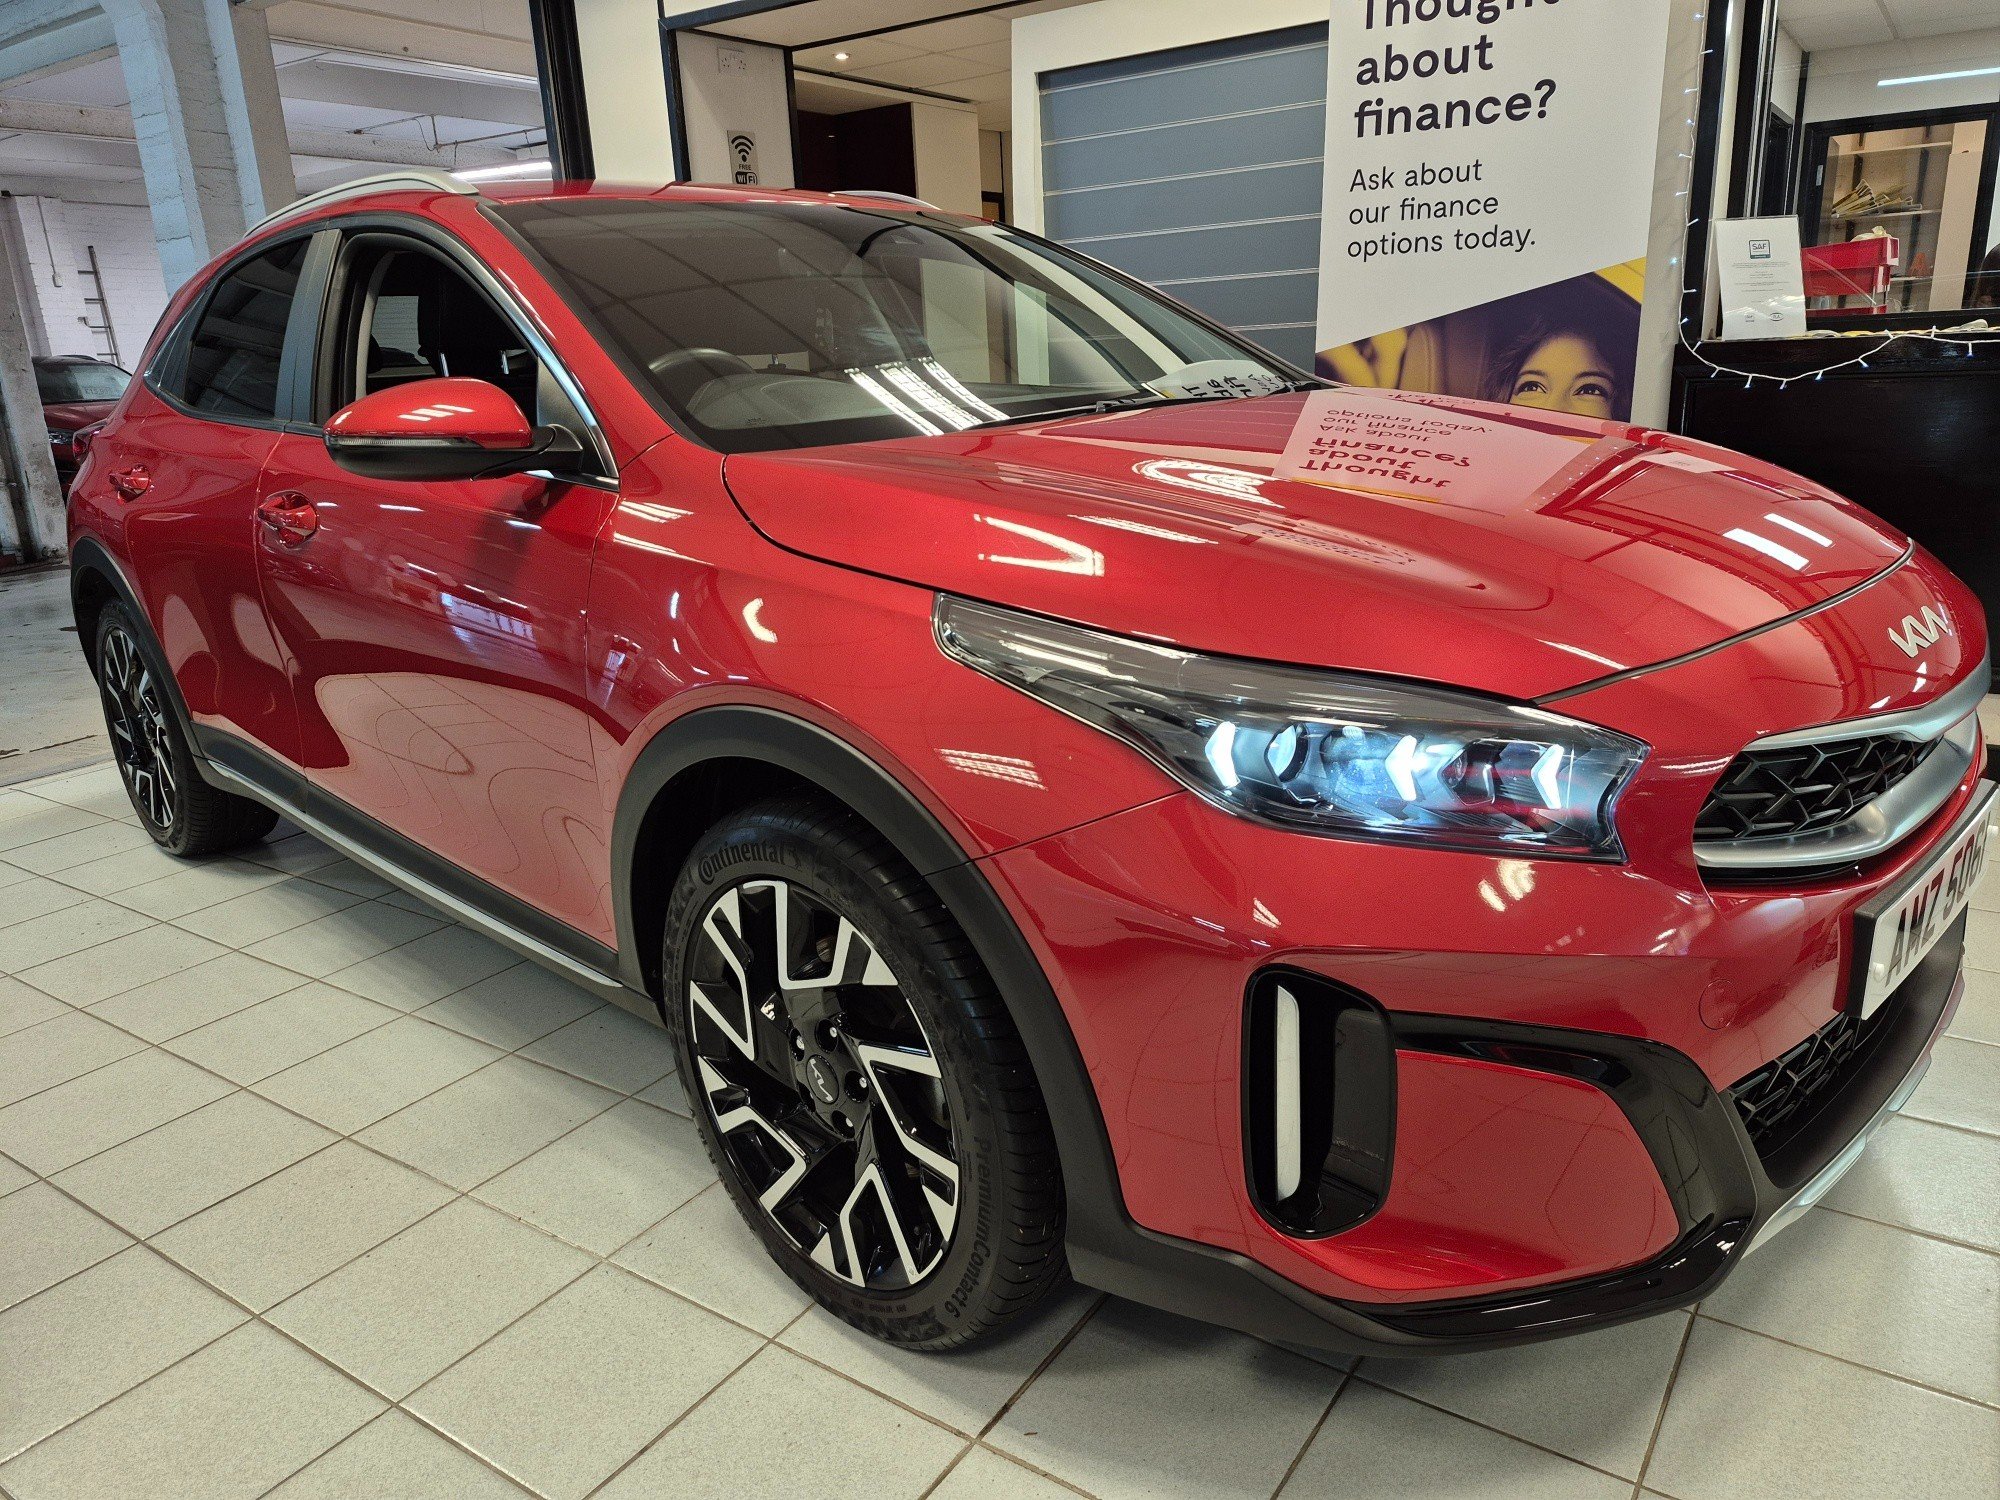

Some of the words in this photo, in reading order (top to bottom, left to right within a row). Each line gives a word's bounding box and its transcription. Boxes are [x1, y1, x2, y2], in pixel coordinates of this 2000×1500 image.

[1359, 0, 1560, 29] Thoug
[1356, 35, 1493, 85] about
[1354, 78, 1556, 138] finance?
[1350, 166, 1395, 192] Ask
[1404, 159, 1482, 187] about
[1349, 205, 1390, 225] our
[1400, 197, 1498, 221] finance
[1347, 232, 1443, 262] options
[1454, 224, 1536, 252] today.
[698, 841, 785, 885] Continental
[1885, 868, 1945, 988] AMZ
[1943, 811, 1991, 921] 5061
[952, 1136, 993, 1307] PremiumContact
[944, 1301, 962, 1318] 6
